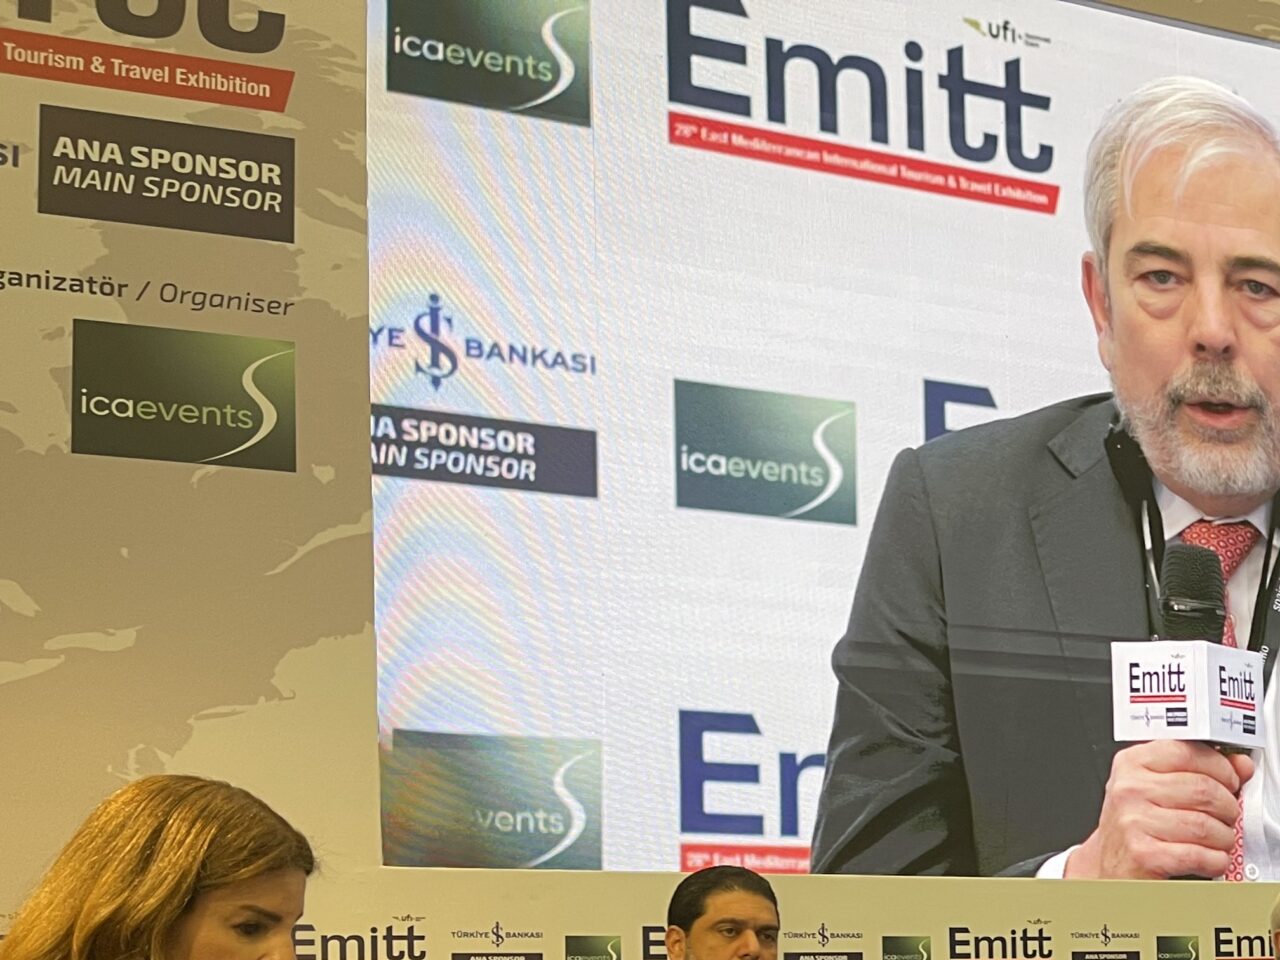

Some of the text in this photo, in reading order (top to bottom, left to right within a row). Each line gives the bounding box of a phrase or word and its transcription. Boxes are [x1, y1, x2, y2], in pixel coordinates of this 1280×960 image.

[3, 42, 271, 98] Tourism & Travel Exhibition
[393, 27, 553, 83] icaevents
[53, 136, 124, 165] ANA
[131, 146, 282, 185] SPONSOR
[53, 165, 282, 213] MAIN SPONSOR
[159, 282, 295, 317] Organiser
[465, 338, 597, 376] BANKASI
[80, 388, 253, 430] icaevents
[402, 418, 536, 455] SPONSOR
[413, 446, 536, 482] SPONSOR
[681, 445, 825, 488] icaevents
[1129, 662, 1186, 693] Emitt
[1218, 665, 1256, 701] Emitt
[949, 926, 1053, 960] Emitt
